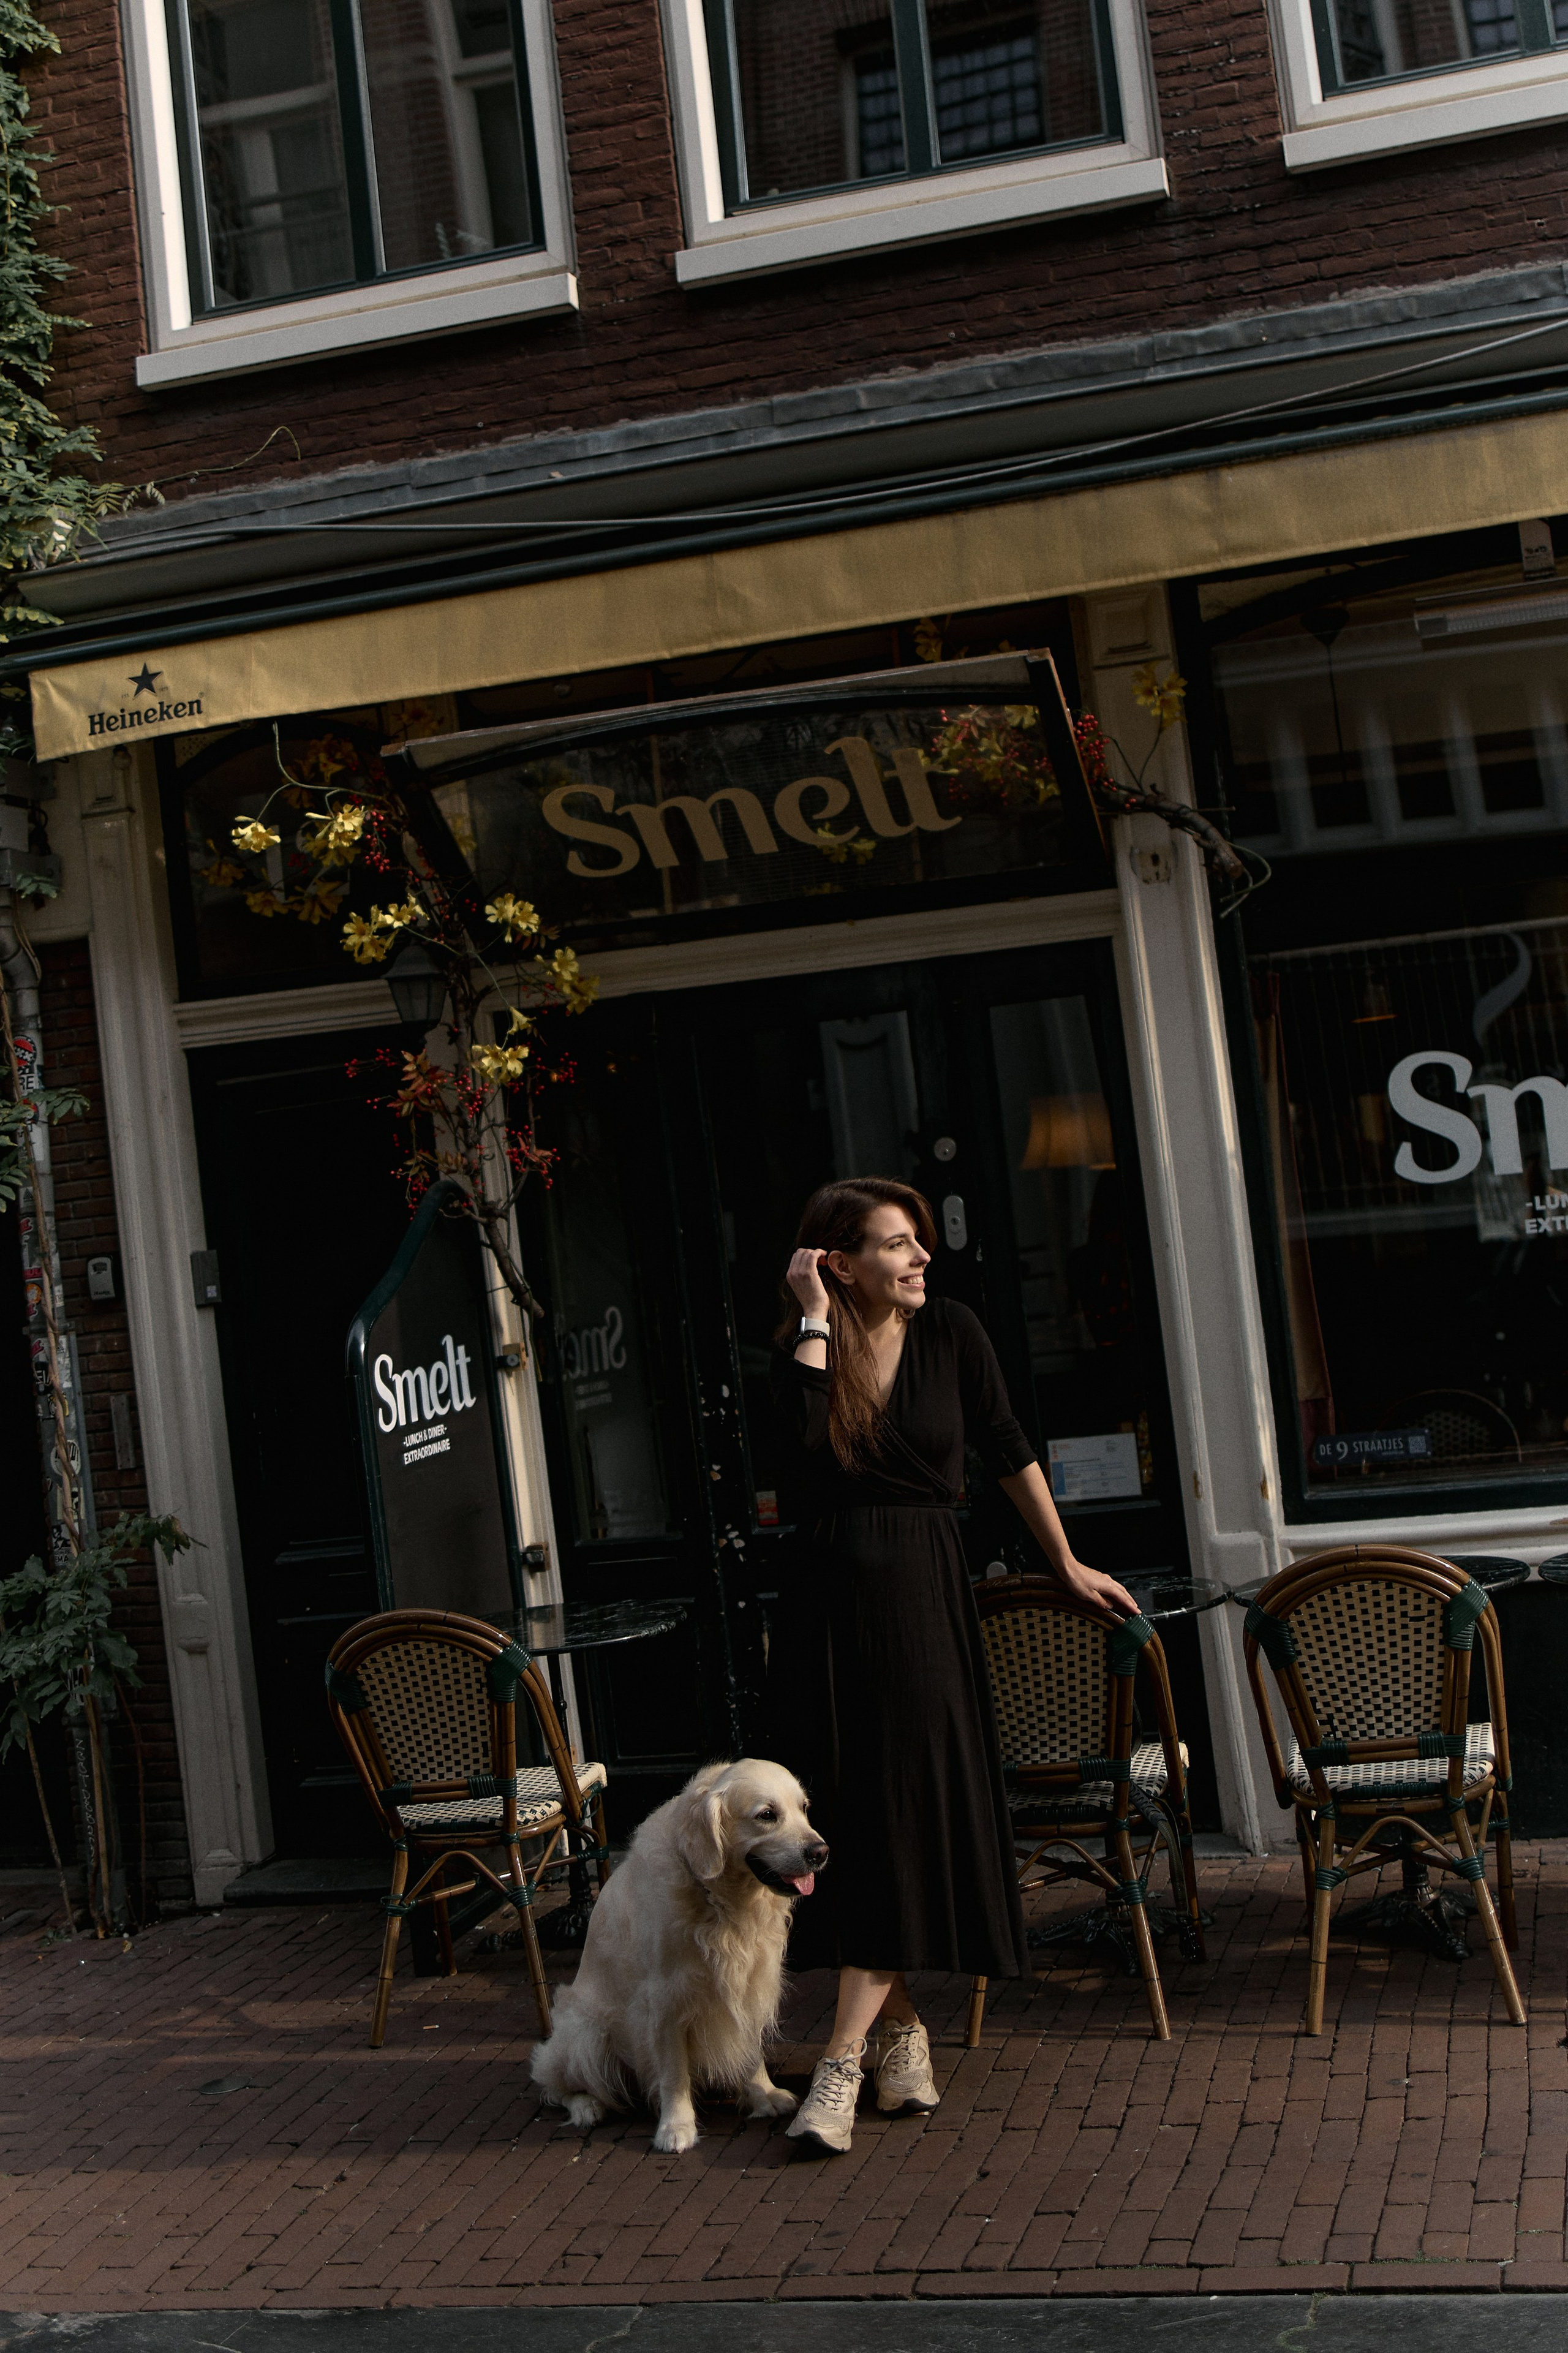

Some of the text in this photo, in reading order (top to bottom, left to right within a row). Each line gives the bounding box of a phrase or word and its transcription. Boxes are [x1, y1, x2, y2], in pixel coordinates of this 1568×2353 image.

[88, 699, 203, 736] Heineken
[542, 736, 962, 878] Smelt
[1525, 1215, 1568, 1234] EXT
[374, 1334, 477, 1432] Smelt
[423, 1429, 428, 1441] &
[404, 1438, 450, 1465] EXTRAORDINAIRE
[1319, 1438, 1404, 1460] DE 9 STRAATJES
